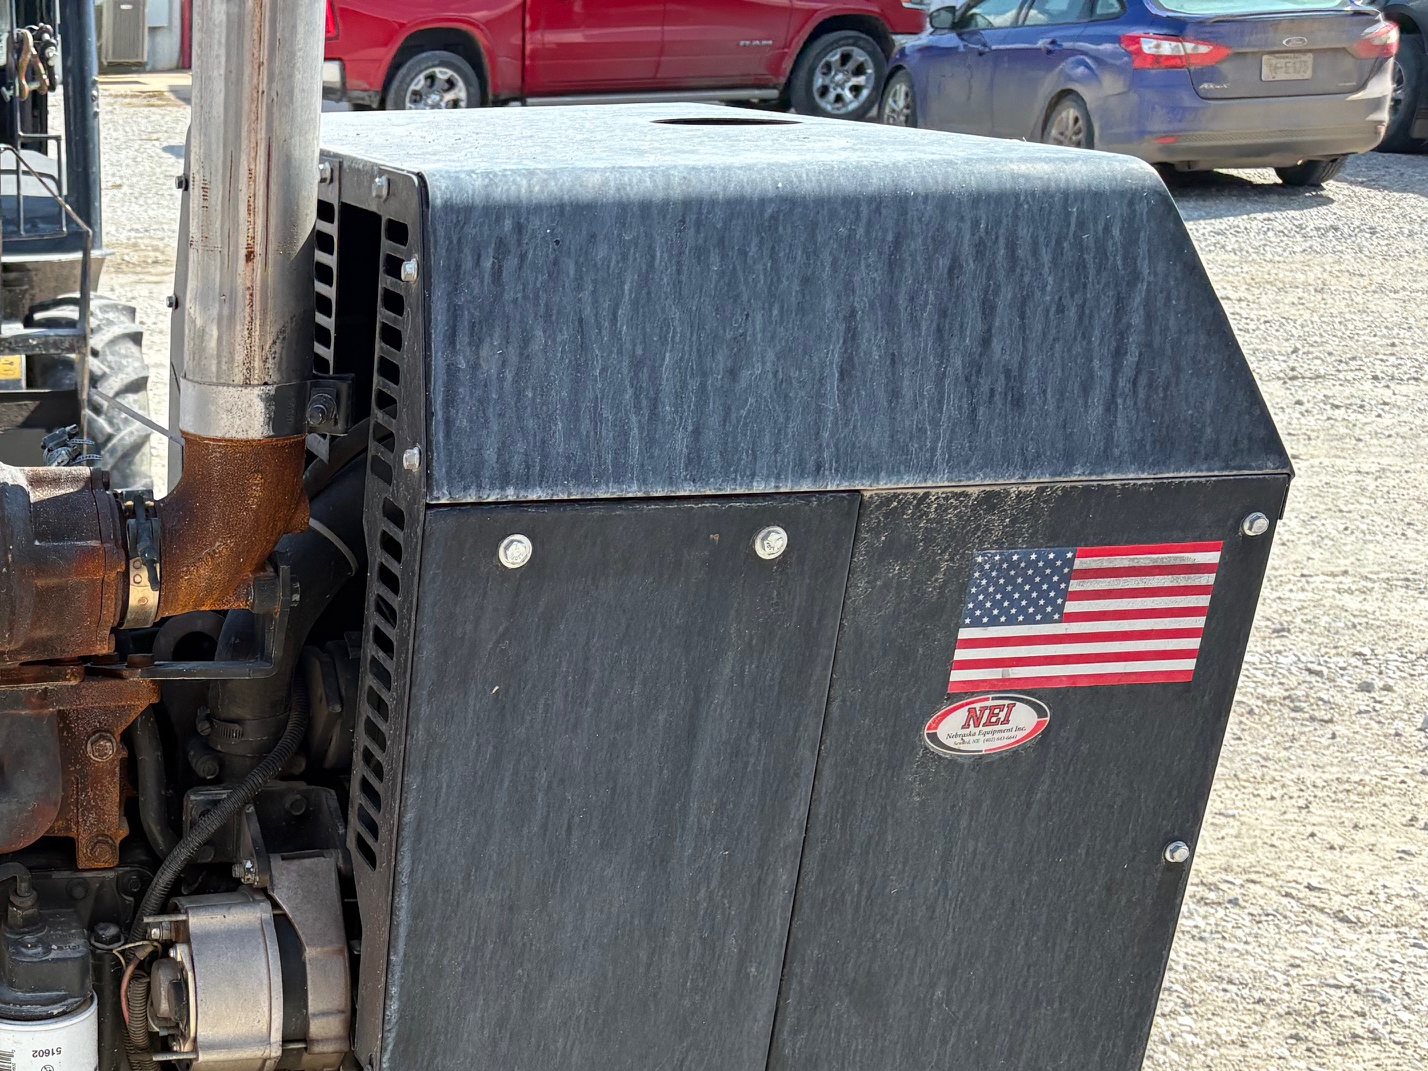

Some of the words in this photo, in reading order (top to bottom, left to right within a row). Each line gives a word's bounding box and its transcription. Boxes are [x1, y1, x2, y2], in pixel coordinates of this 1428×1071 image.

[961, 703, 1017, 730] NEI
[945, 730, 976, 740] Nebraska
[978, 727, 1013, 738] Equipment
[32, 1047, 62, 1058] 51602
